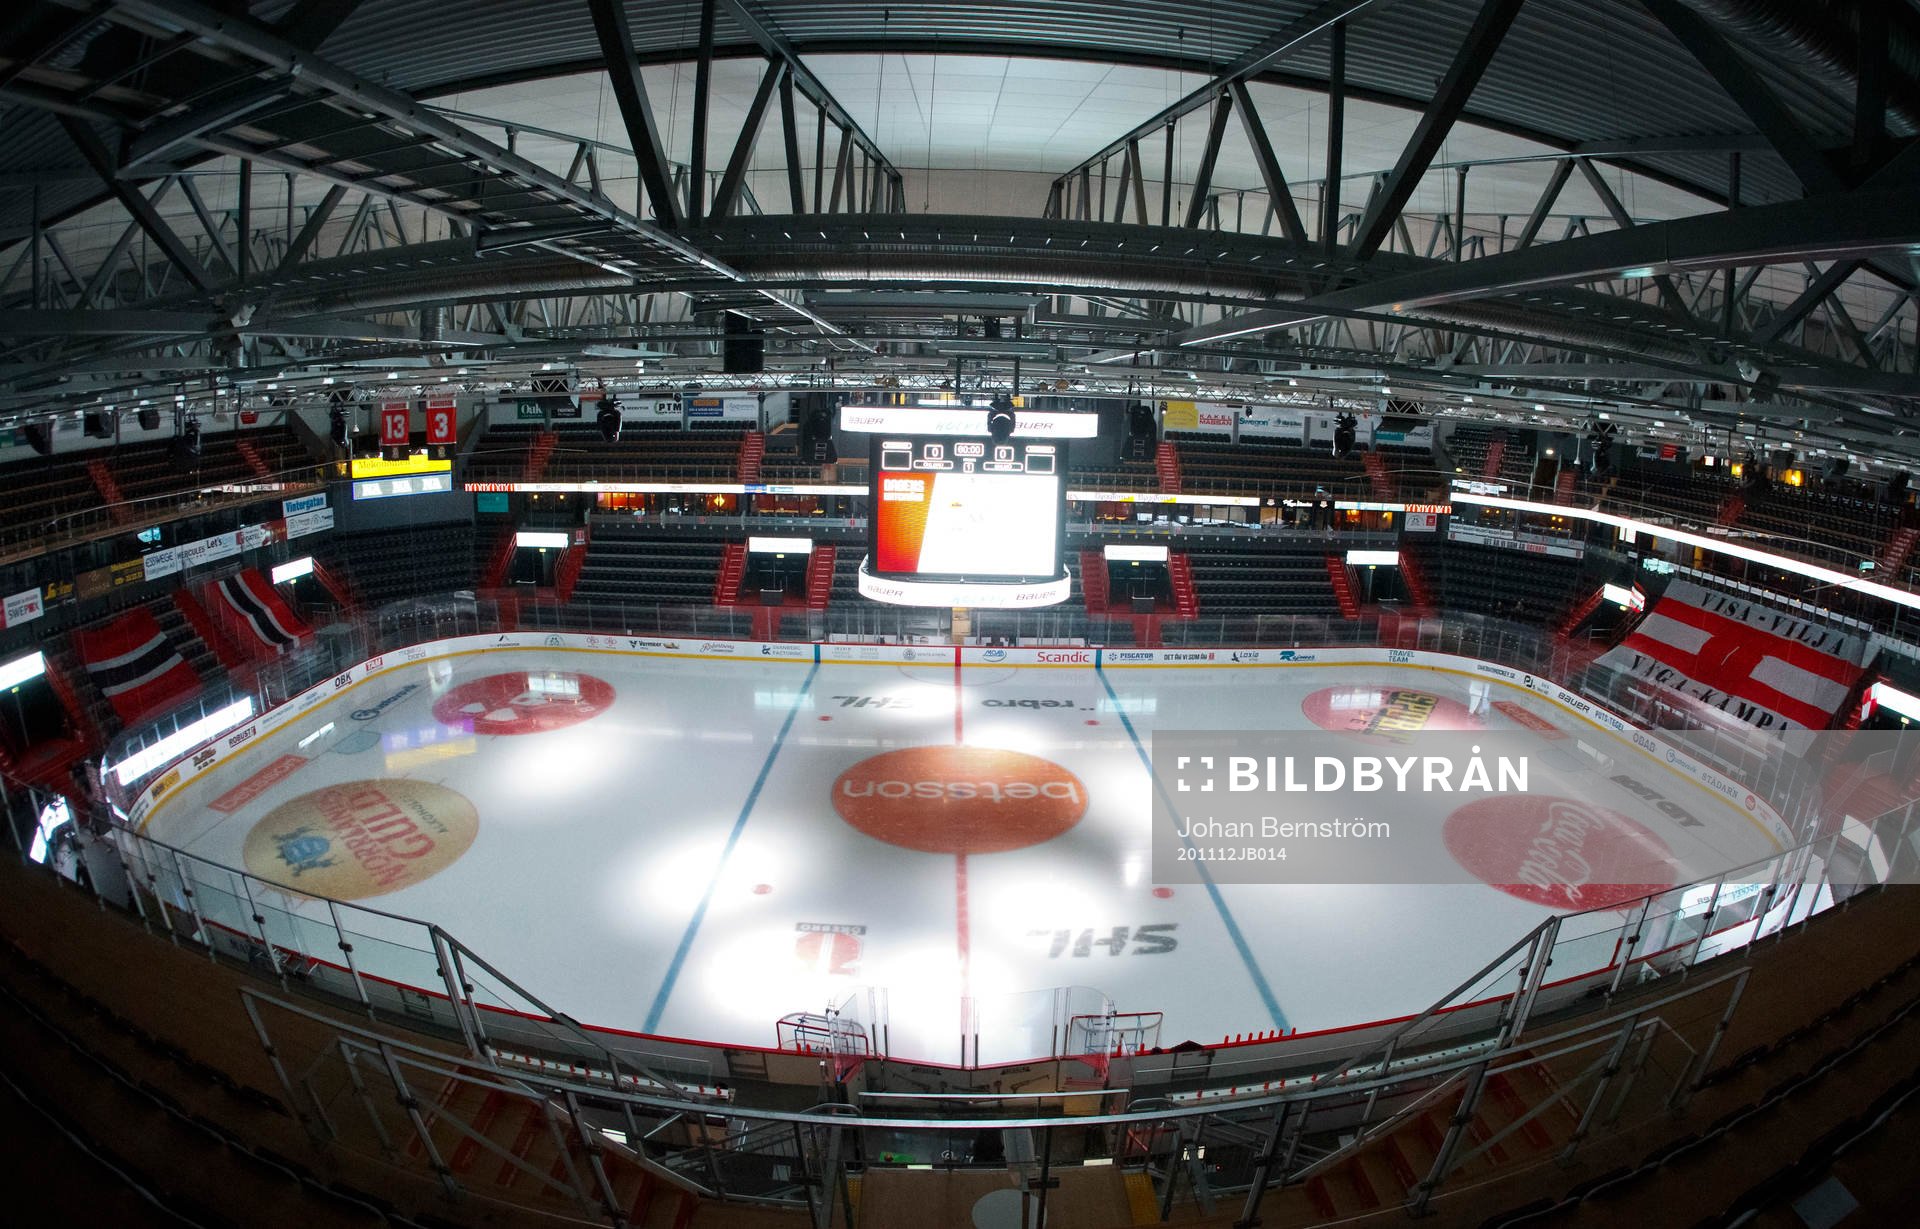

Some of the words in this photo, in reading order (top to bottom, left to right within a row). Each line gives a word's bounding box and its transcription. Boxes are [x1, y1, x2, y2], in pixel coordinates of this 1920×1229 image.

[521, 404, 543, 415] Oak
[658, 403, 682, 411] PTM
[386, 415, 405, 439] 13
[434, 412, 448, 438] 3
[1014, 422, 1054, 430] AUER
[1239, 417, 1269, 427] Swegon
[932, 447, 939, 458] 0
[957, 446, 981, 456] 00:00
[999, 449, 1006, 459] 0
[285, 497, 325, 513] Vintergatan
[206, 537, 222, 549] Let's
[1700, 591, 1750, 622] VISA
[1768, 615, 1846, 656] VILJA
[1037, 651, 1090, 663] Scandic
[335, 673, 352, 687] OBK
[1699, 692, 1789, 742] KÄMPA
[229, 727, 252, 747] ROBUST
[842, 779, 1080, 804] betsson
[351, 787, 436, 860] GULD
[1027, 923, 1179, 959] SHL
